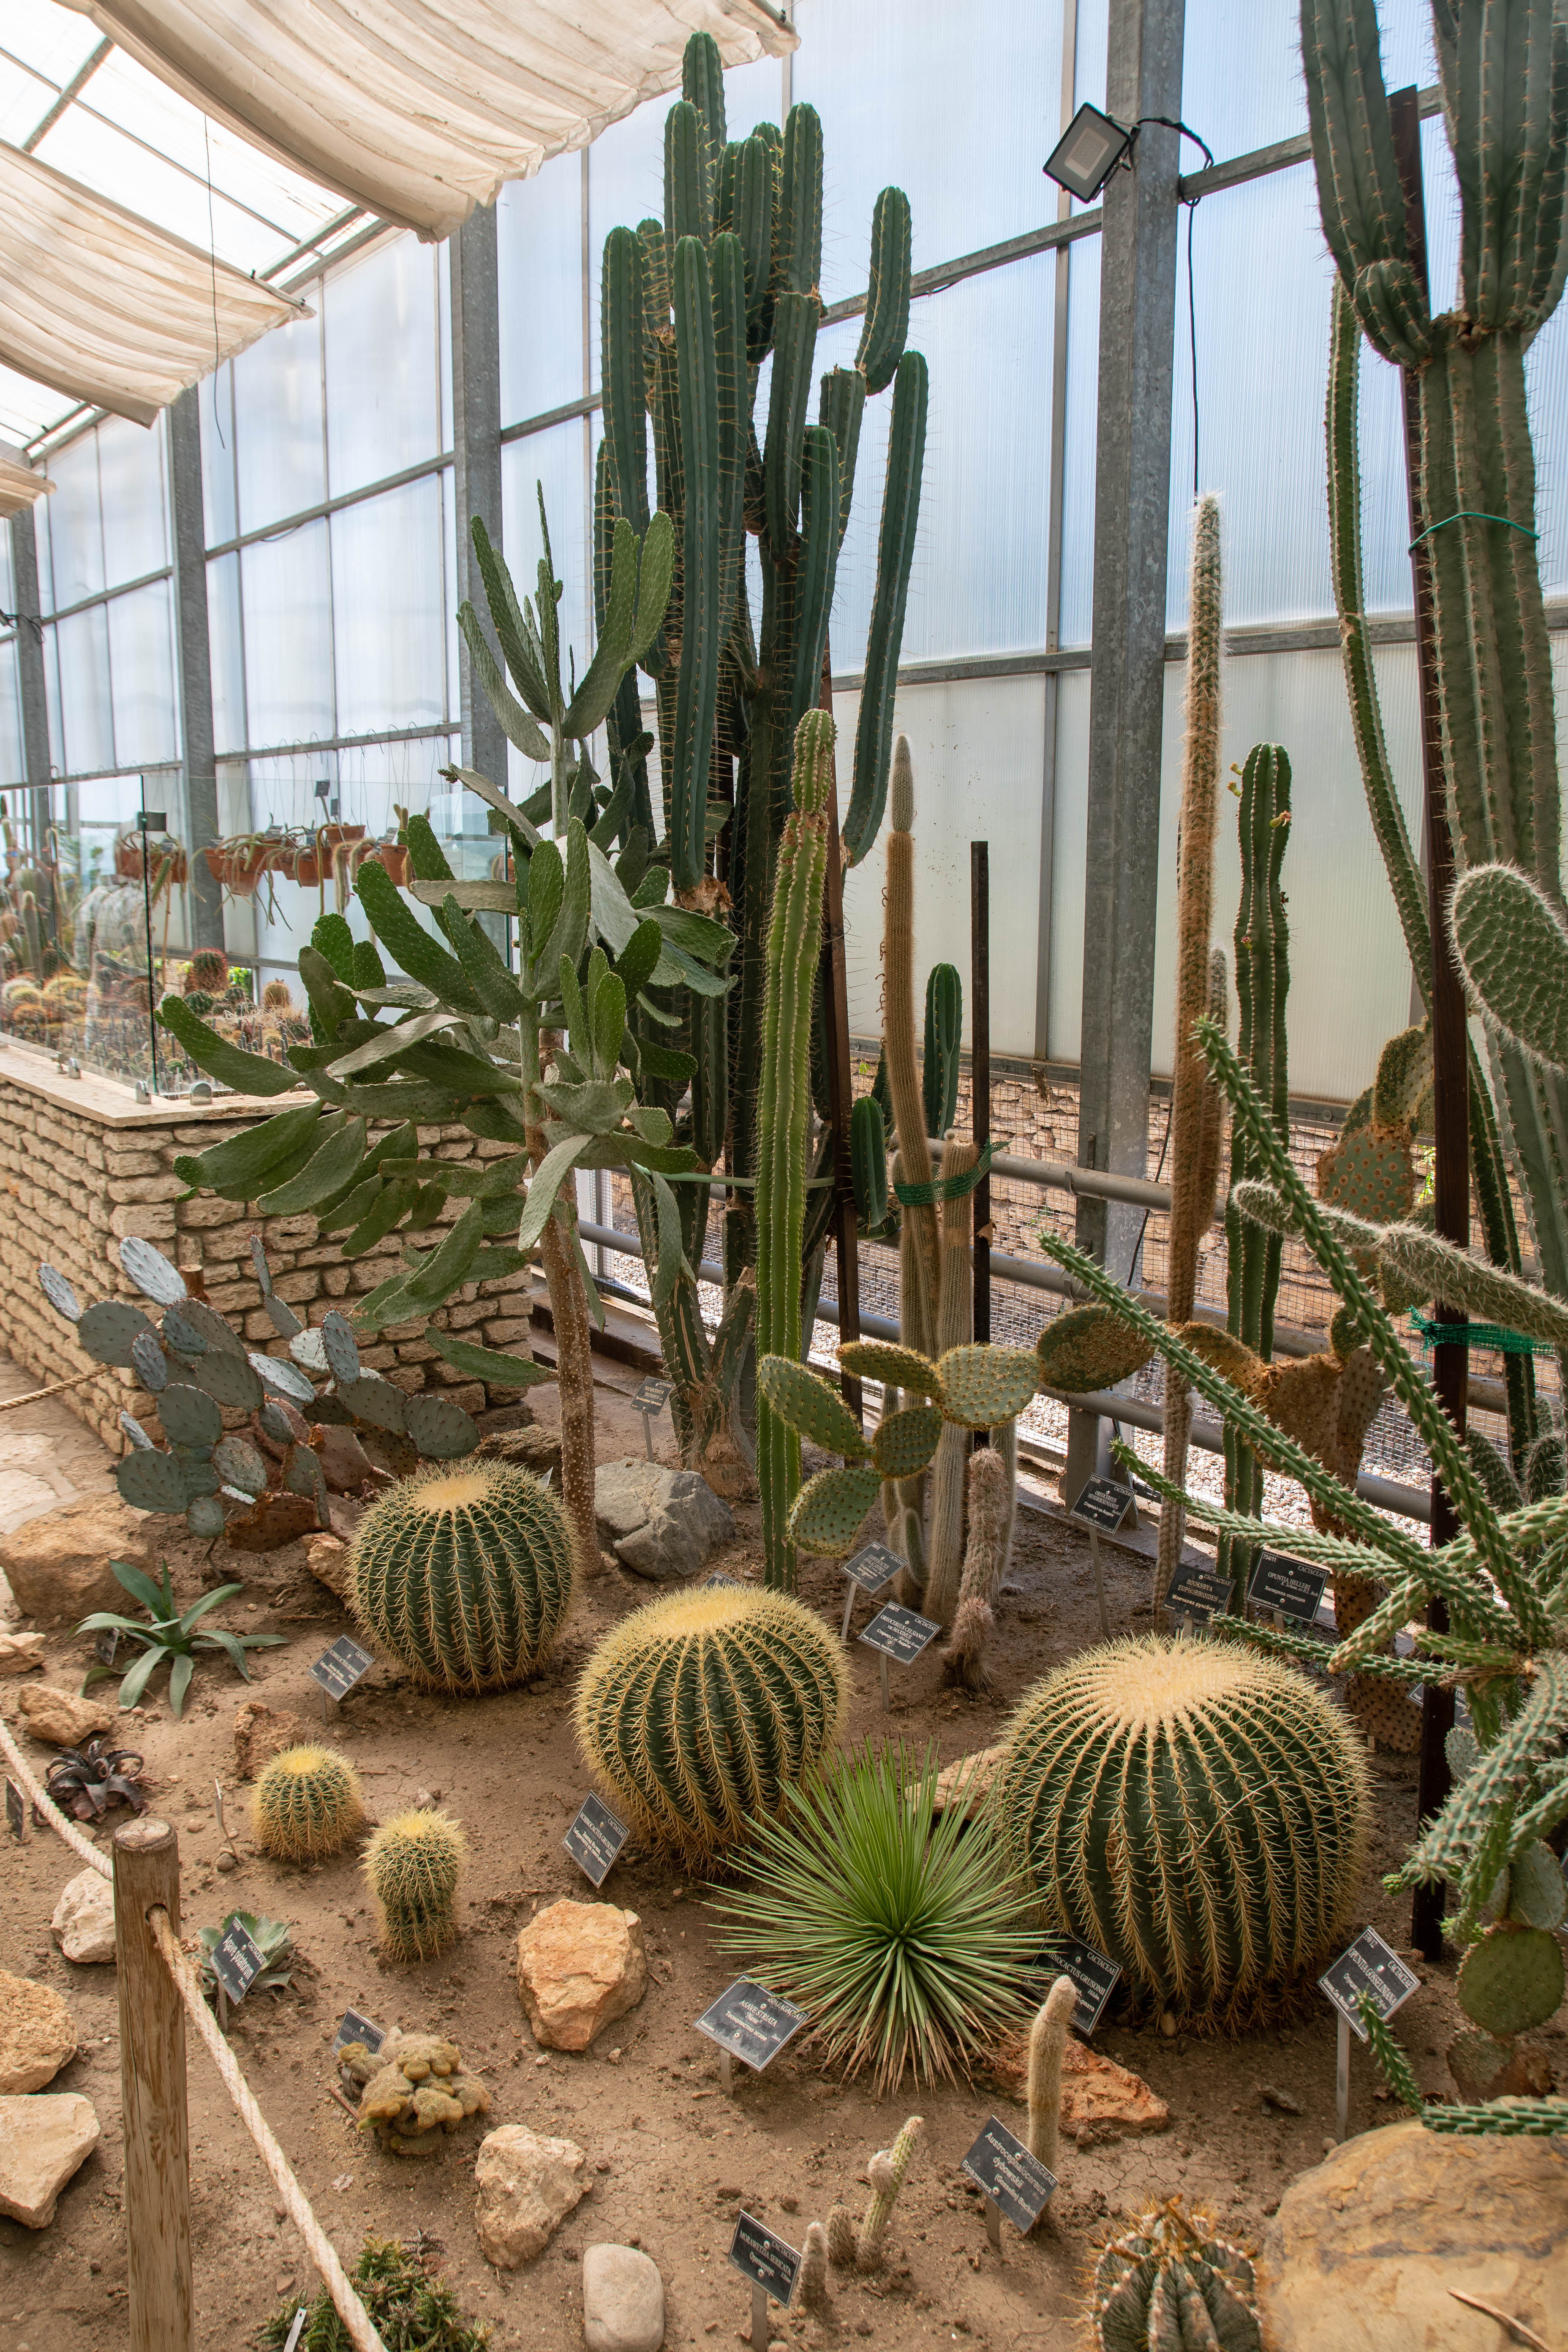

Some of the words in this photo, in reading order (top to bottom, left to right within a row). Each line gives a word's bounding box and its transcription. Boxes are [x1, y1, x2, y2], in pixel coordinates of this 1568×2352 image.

[1095, 1491, 1116, 1502] OREOCEREUS
[1114, 1486, 1132, 1497] CACTACEAE
[1263, 1554, 1276, 1562] 754/11
[1204, 1574, 1230, 1586] CACTACEAE
[1268, 1572, 1288, 1582] OPUNTIA
[1290, 1579, 1310, 1590] HELLERI
[1298, 1565, 1324, 1578] CACTACEAE
[1179, 1585, 1217, 1601] EUPHORBIOIDES
[1187, 1579, 1212, 1591] ROOKSBYA
[1265, 1586, 1285, 1596] Хелерева
[1287, 1594, 1304, 1603] опунция
[1173, 1595, 1194, 1604] Млечкова
[881, 1615, 905, 1629] OREOCEREUS
[905, 1628, 926, 1640] CELSIANUS
[915, 1618, 936, 1631] CACTACEAE
[877, 1629, 893, 1639] Старецът
[898, 1640, 911, 1649] Андите
[573, 1827, 588, 1847] Табуретката
[580, 1812, 601, 1838] ECHINOCACTUS
[601, 1835, 615, 1854] GRUSONII
[607, 1818, 624, 1838] CACTACEAE
[221, 1932, 239, 1960] Agave
[231, 1947, 254, 1984] potatorum
[248, 1941, 264, 1965] CACTACEAE
[1086, 1952, 1116, 1974] CACTACEAE
[238, 1976, 247, 1990] Zucc.
[1079, 1974, 1105, 1995] GRUSONII
[1348, 1948, 1369, 1972] OPUNTIA
[1365, 1968, 1397, 2006] GOSSELINIANA
[1388, 1960, 1412, 1989] CACTACEAE
[739, 2000, 757, 2013] AGAVE
[756, 2010, 778, 2026] STRIATA
[766, 1997, 805, 2022] SPARAGACAE
[725, 2011, 754, 2032] Теснолистно
[753, 2031, 767, 2042] агаве
[771, 2034, 782, 2042] Zucc.
[985, 2131, 1046, 2196] Austrocephalocereus
[992, 2155, 1023, 2190] dybowskii
[1021, 2150, 1055, 2186] CACTACEAE
[962, 2160, 992, 2194] Бразилия
[740, 2231, 769, 2258] MORAWETZIA
[770, 2254, 791, 2275] SERICATA
[773, 2241, 796, 2262] CACTACEAE
